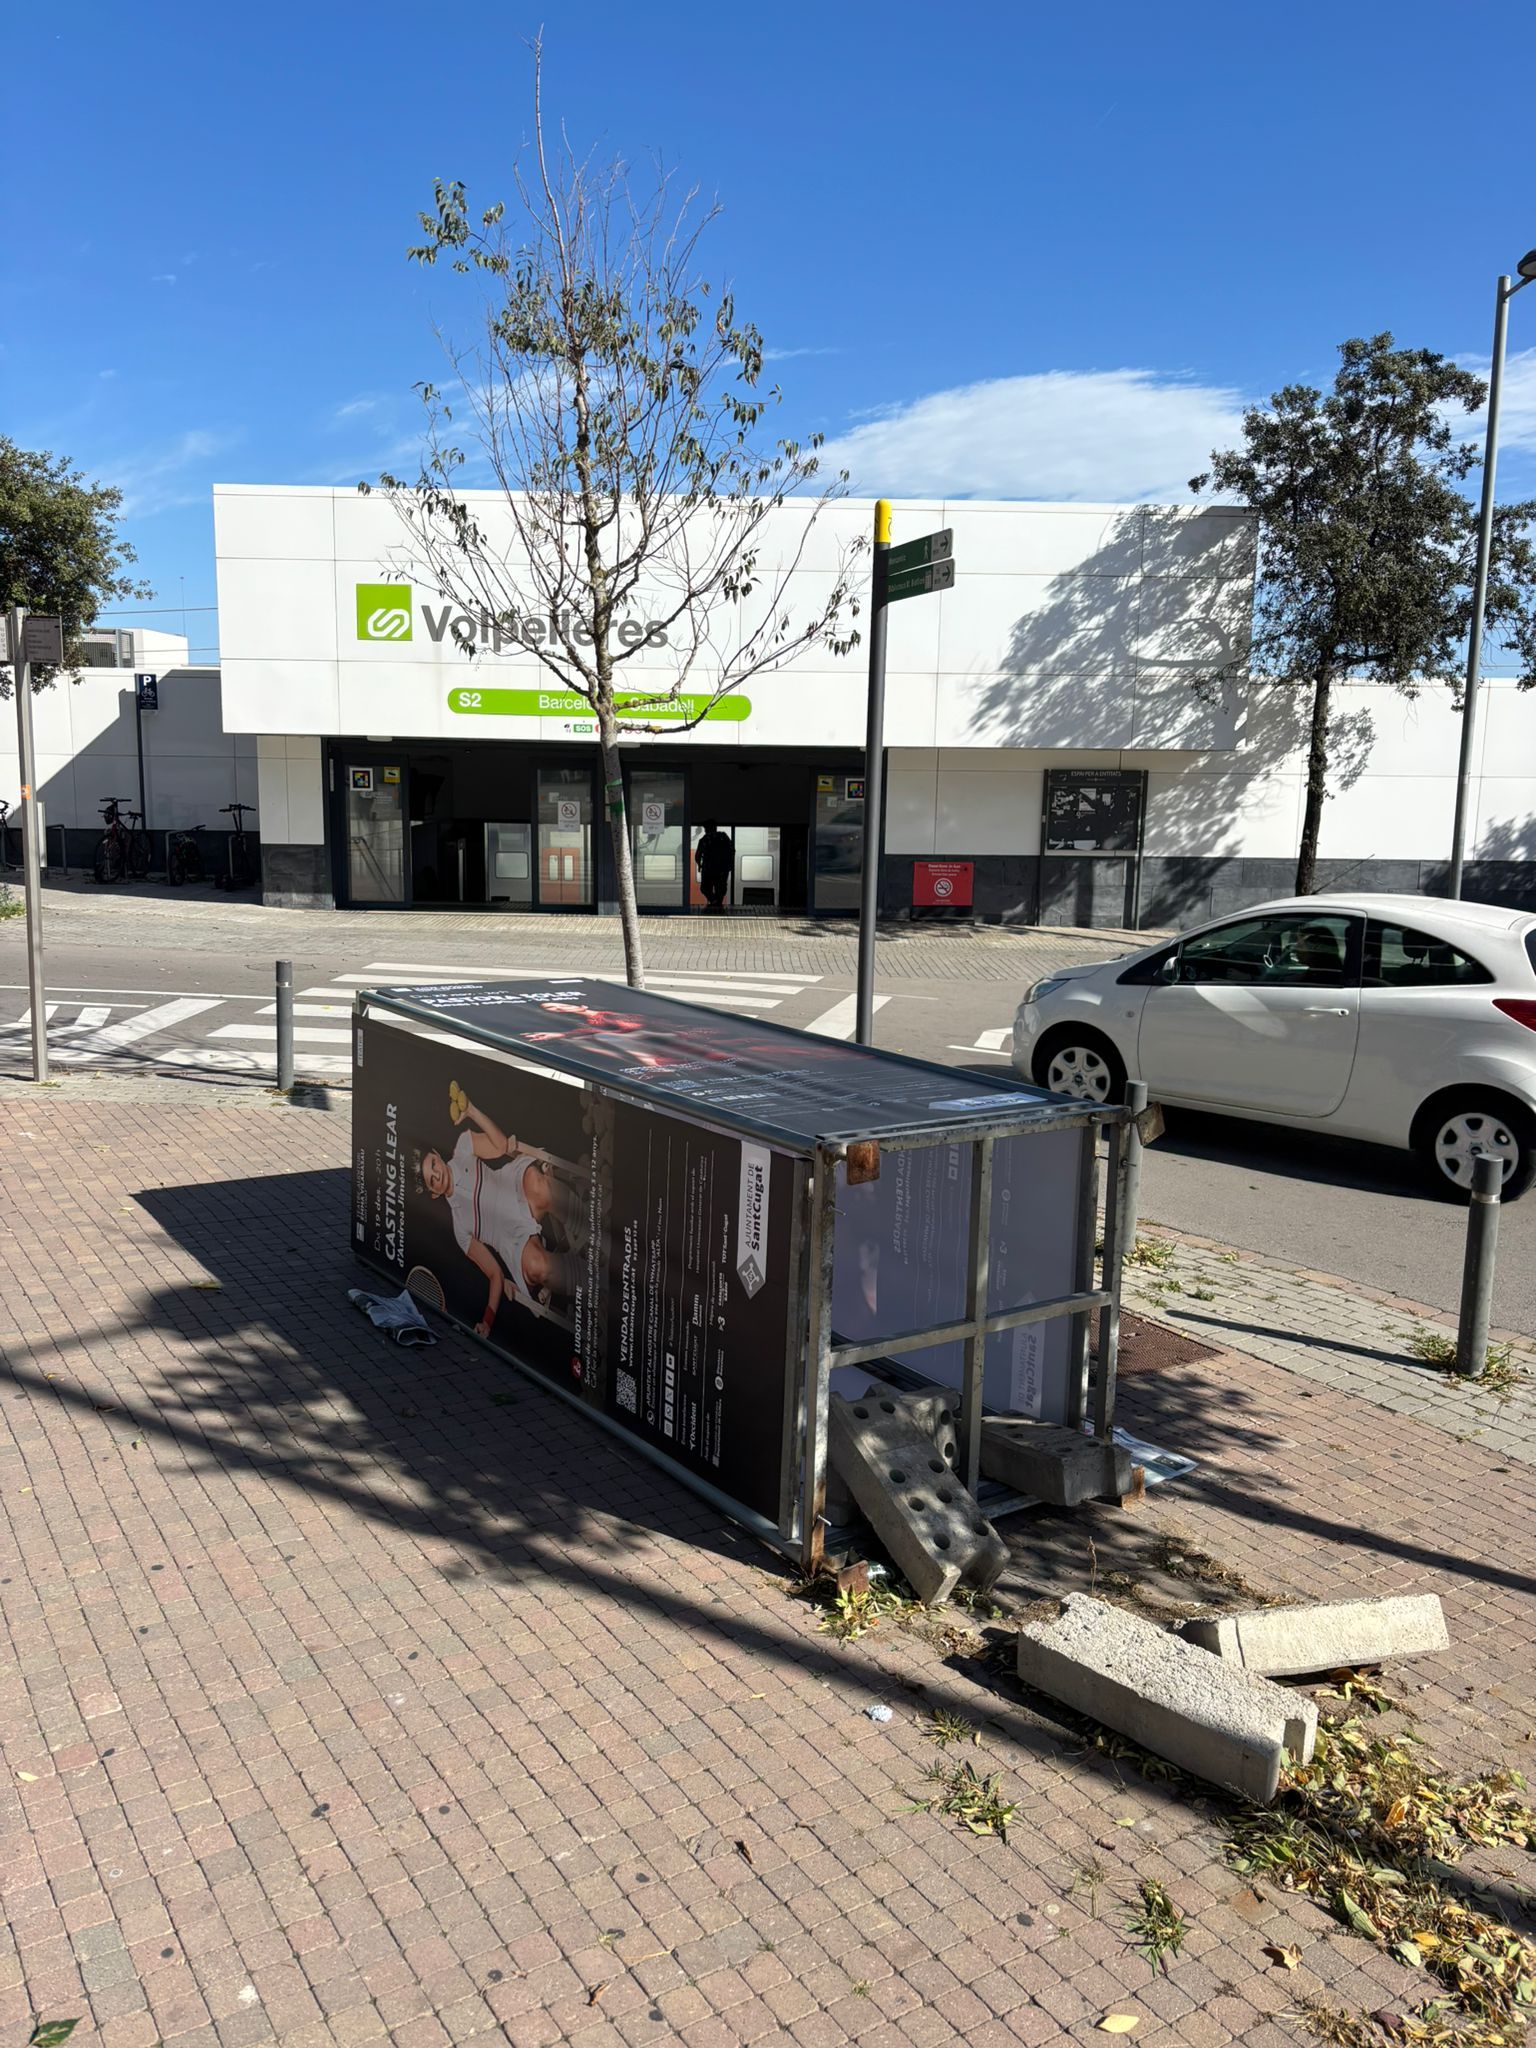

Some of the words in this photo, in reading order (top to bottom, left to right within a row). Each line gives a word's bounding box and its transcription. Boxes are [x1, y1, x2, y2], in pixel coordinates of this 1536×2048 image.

[143, 675, 152, 687] P
[459, 692, 482, 708] S2
[420, 995, 522, 1004] PASTORA
[386, 1102, 398, 1161] LEAR
[398, 1154, 406, 1208] Jiménez
[591, 1160, 596, 1170] 12
[747, 1162, 754, 1175] DE
[385, 1164, 396, 1260] CASTING
[589, 1186, 596, 1198] de
[745, 1176, 754, 1248] AJUNTAMENT
[751, 1165, 764, 1252] SantCugat
[375, 1214, 381, 1228] 19
[397, 1211, 405, 1268] d'Andrea
[622, 1226, 632, 1312] D'ENTRADES
[574, 1284, 582, 1354] LUDOTEATRE
[648, 1358, 652, 1368] AL
[650, 1286, 654, 1296] DE
[692, 1294, 700, 1326] Damm
[586, 1343, 591, 1355] de
[620, 1316, 628, 1362] VENDA
